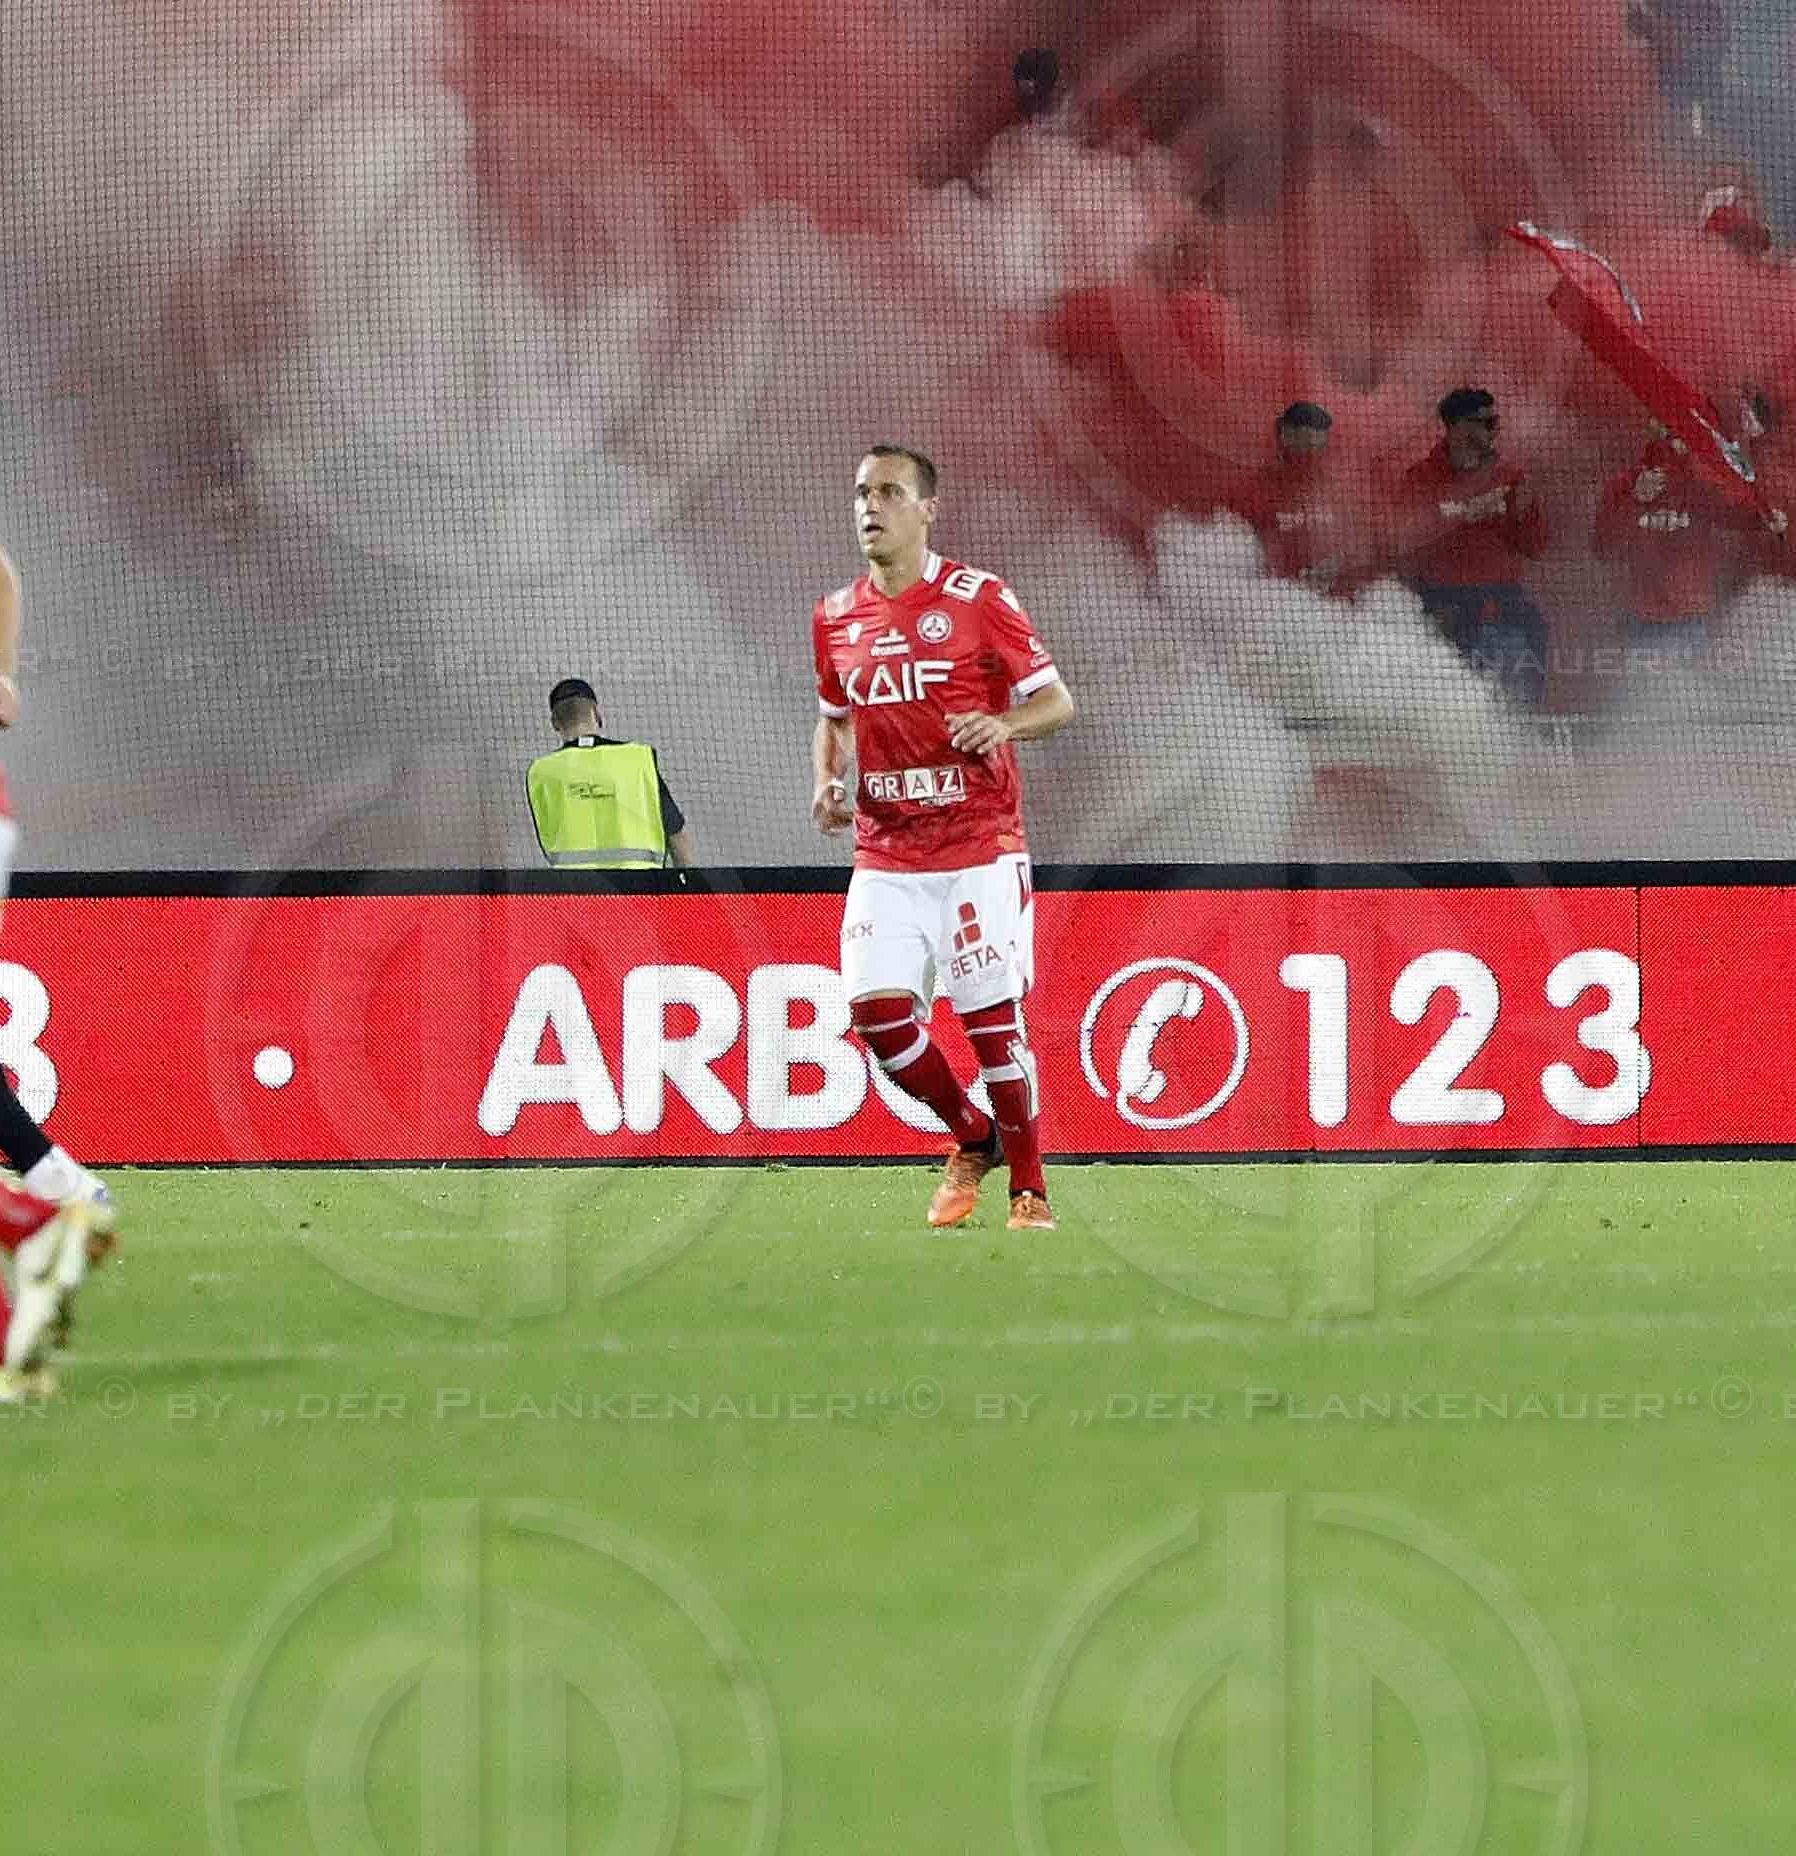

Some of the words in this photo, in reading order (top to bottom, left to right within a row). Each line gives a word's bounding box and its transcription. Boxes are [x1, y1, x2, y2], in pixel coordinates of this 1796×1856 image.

[839, 660, 955, 706] KAIF
[866, 768, 959, 800] GRAZ
[951, 945, 1002, 977] BETA
[477, 963, 1030, 1137] ARB
[1279, 949, 1652, 1128] 123
